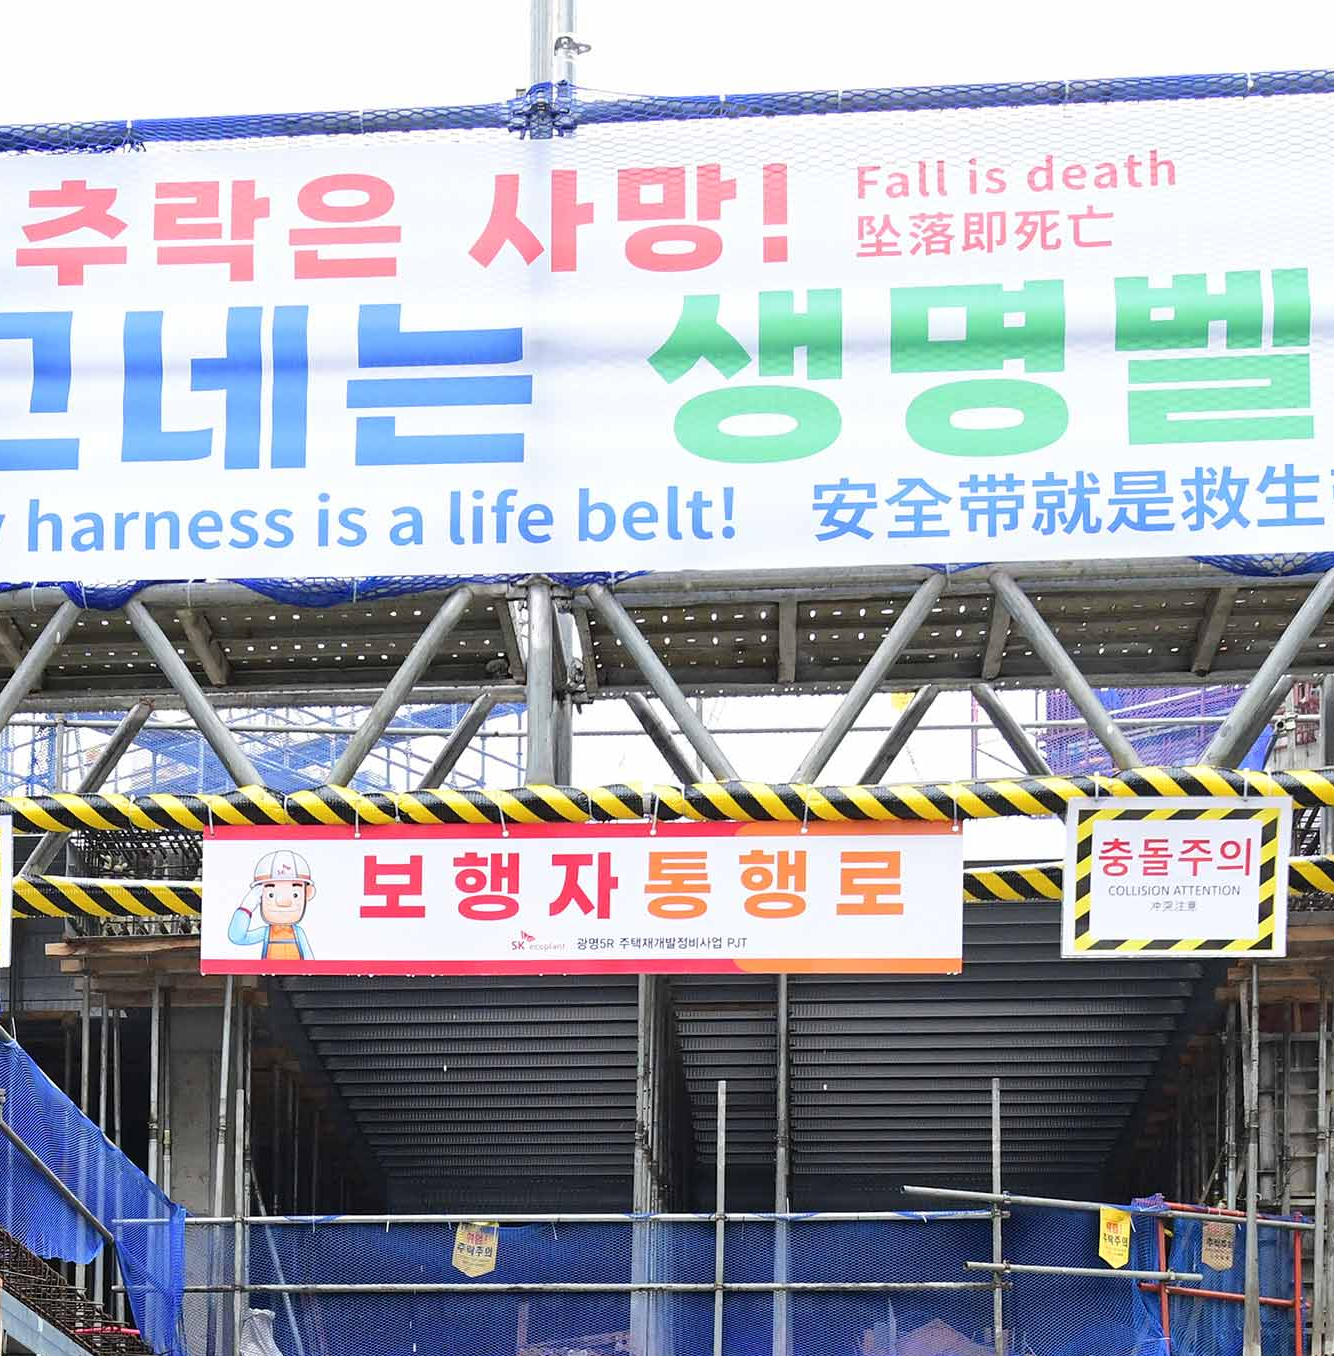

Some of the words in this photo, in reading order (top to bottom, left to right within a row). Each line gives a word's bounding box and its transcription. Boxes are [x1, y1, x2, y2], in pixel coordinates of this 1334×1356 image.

[857, 160, 946, 199] Fall
[969, 157, 1007, 195] is
[1027, 149, 1176, 193] death
[16, 173, 402, 286] 추락은
[468, 163, 788, 273] 사망!
[857, 205, 1114, 258] 坠落即死亡
[27, 498, 294, 553] harness
[318, 492, 368, 548] is
[389, 506, 424, 546] a
[449, 488, 554, 545] life
[578, 485, 738, 543] belt!
[1099, 838, 1252, 877] 충돌주의
[1108, 885, 1170, 897] COLLISION
[1173, 885, 1241, 896] ATTENTION
[576, 937, 614, 950] 광명5R
[619, 937, 723, 950] 주택재개발정비사업
[727, 937, 748, 949] PJT
